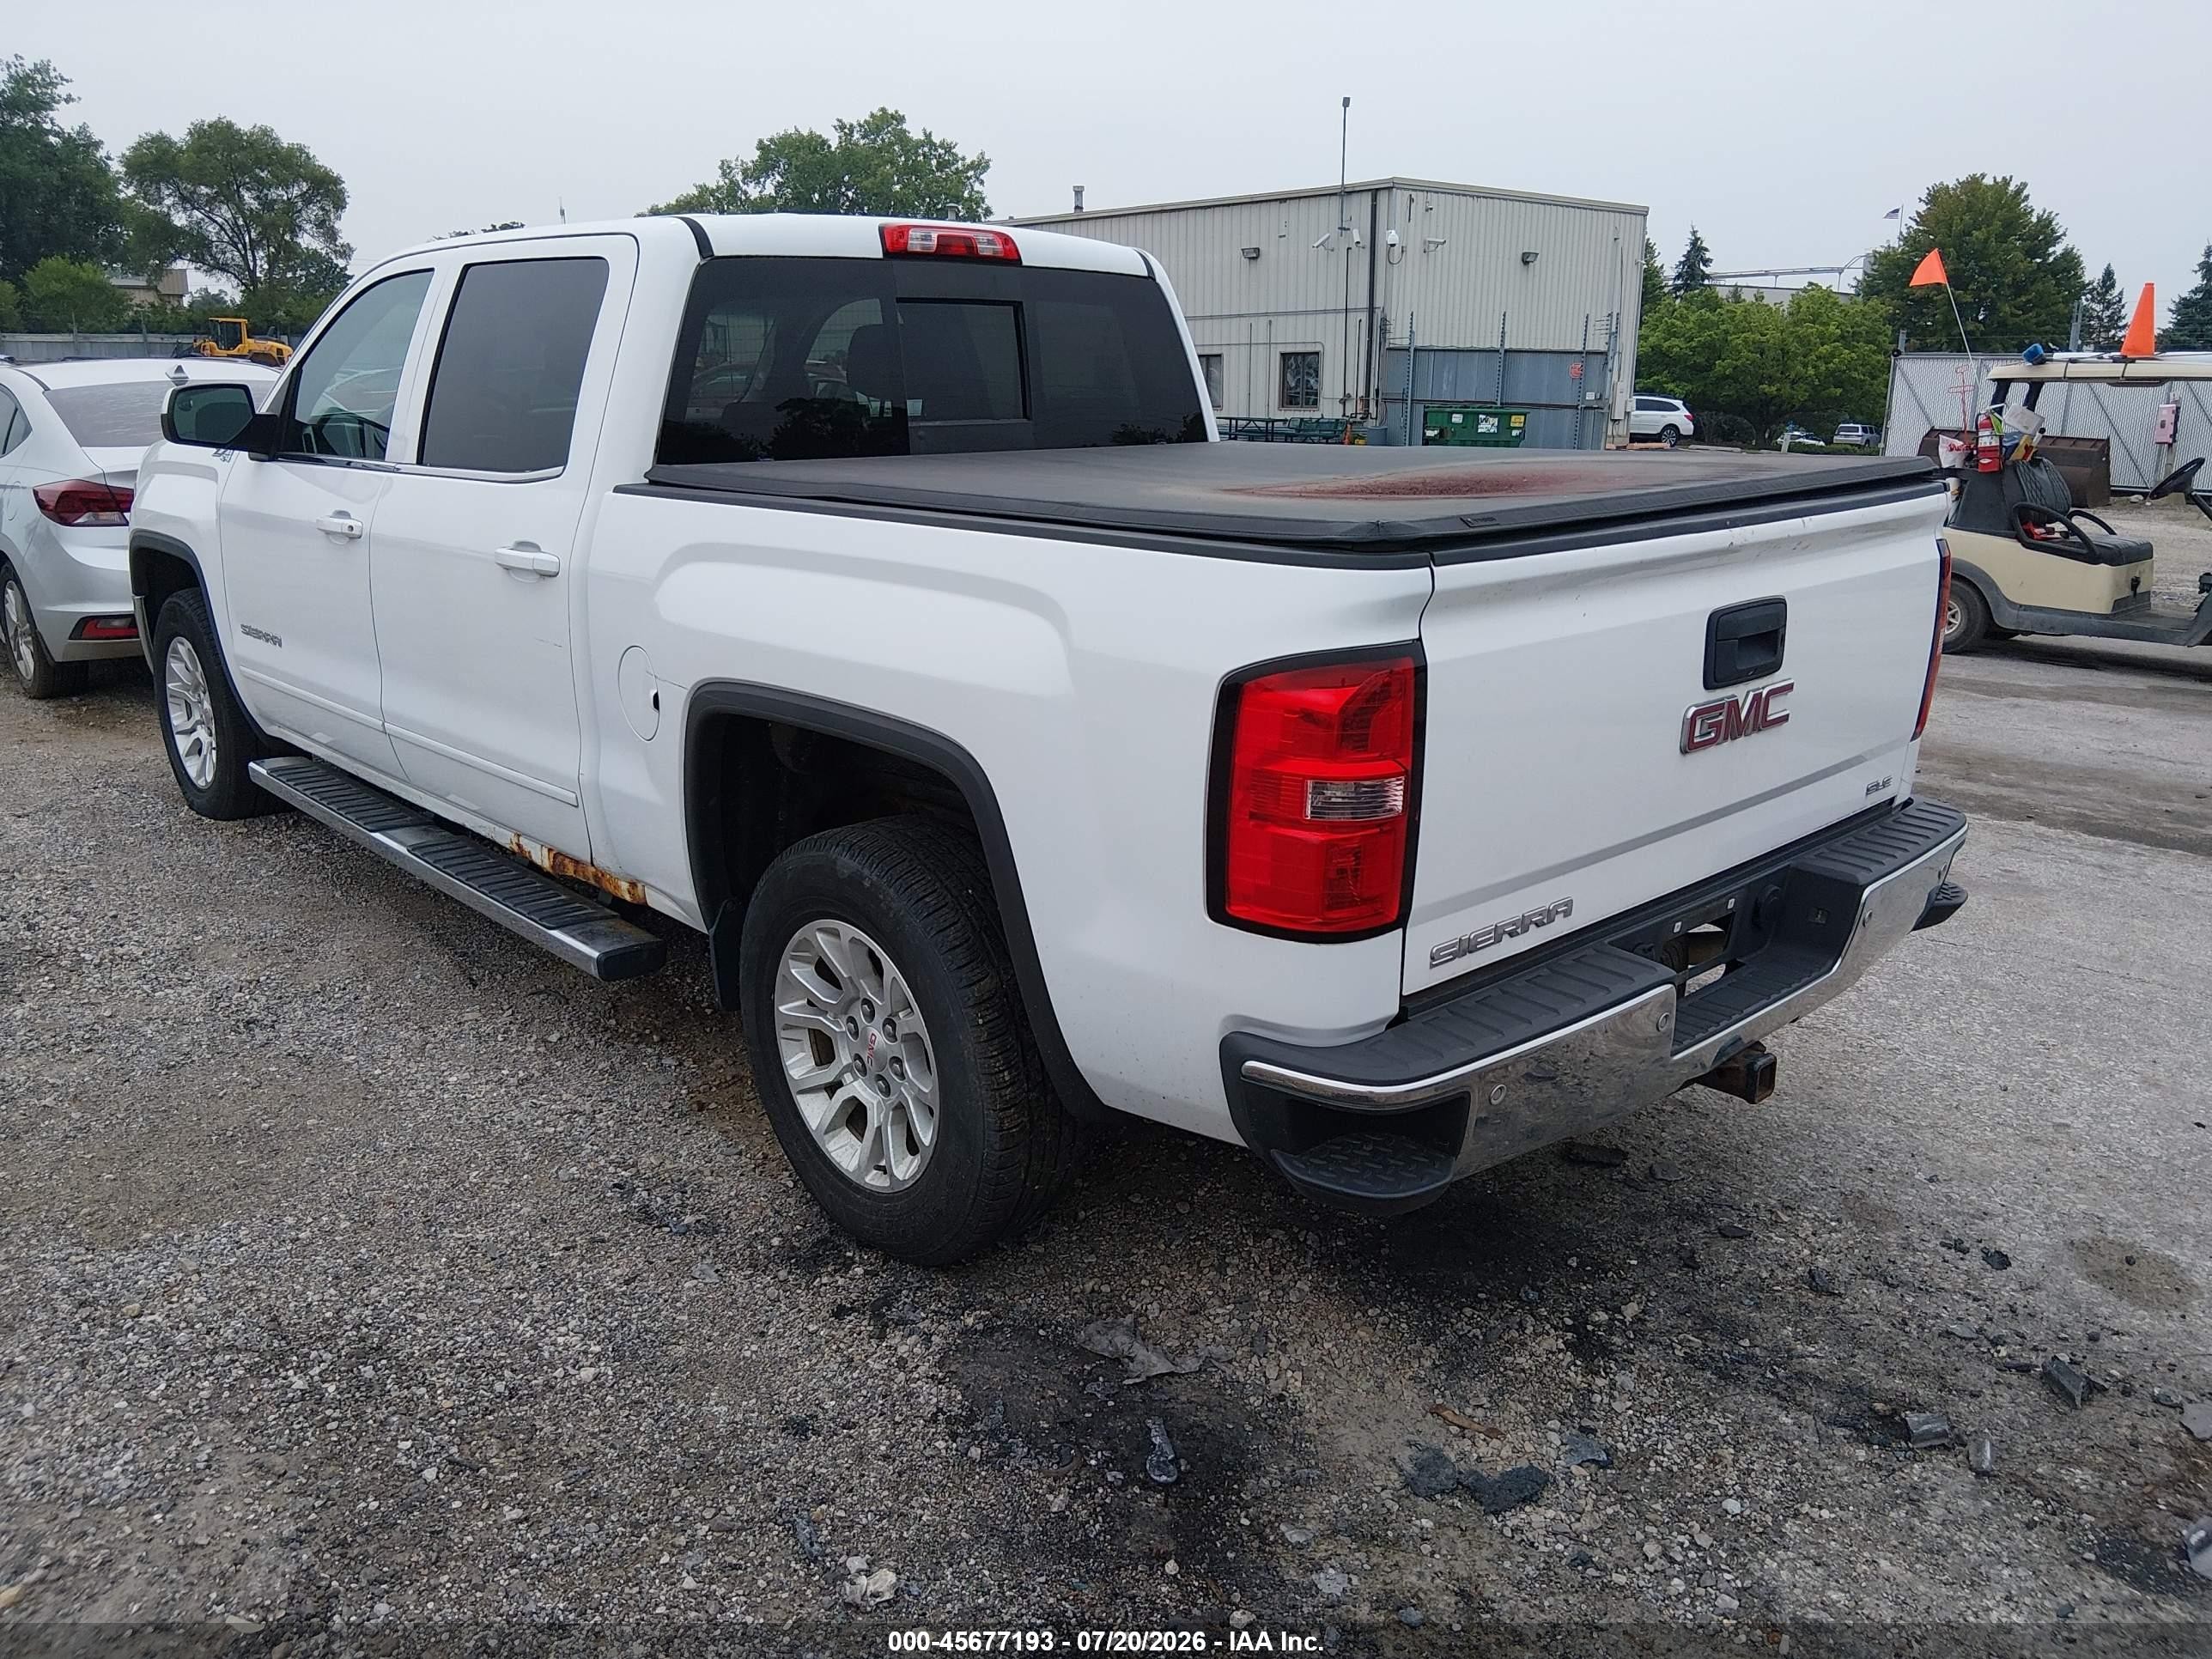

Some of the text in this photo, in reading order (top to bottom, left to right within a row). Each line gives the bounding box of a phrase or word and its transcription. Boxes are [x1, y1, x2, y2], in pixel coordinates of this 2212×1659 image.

[1680, 678, 1794, 754] GMC
[1866, 775, 1893, 794] SLE
[1430, 896, 1574, 969] SIERRA
[867, 1033, 877, 1066] GMC
